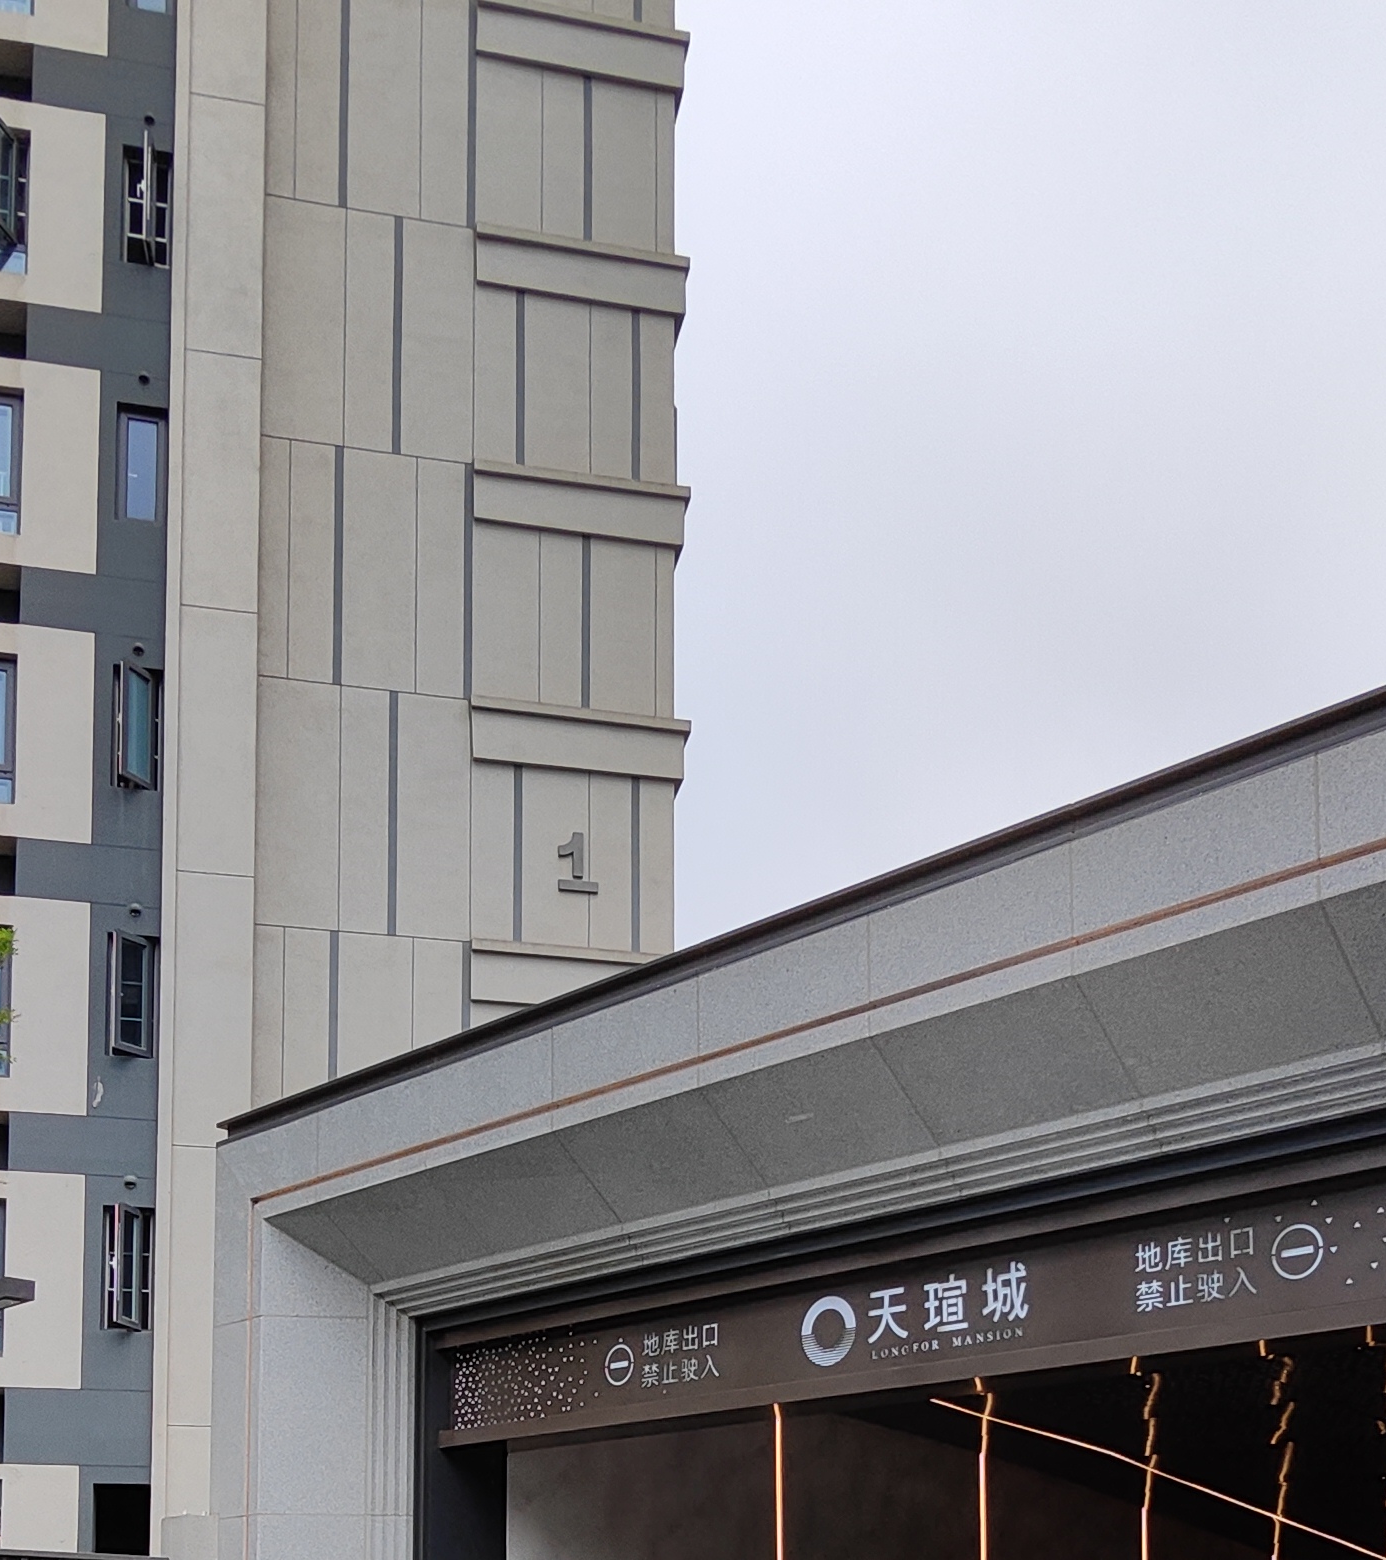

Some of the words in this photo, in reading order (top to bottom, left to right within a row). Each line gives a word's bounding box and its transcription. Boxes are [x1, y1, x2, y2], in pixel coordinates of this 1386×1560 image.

[558, 832, 599, 894] 1
[1135, 1227, 1254, 1273] 地库出口
[867, 1261, 1029, 1344] 天瑄城
[1135, 1267, 1257, 1312] 禁止驶入
[641, 1323, 718, 1357] 地库出口
[871, 1340, 940, 1360] LONGFOR
[952, 1327, 1024, 1348] MANSION
[641, 1354, 720, 1388] 禁止驶入
